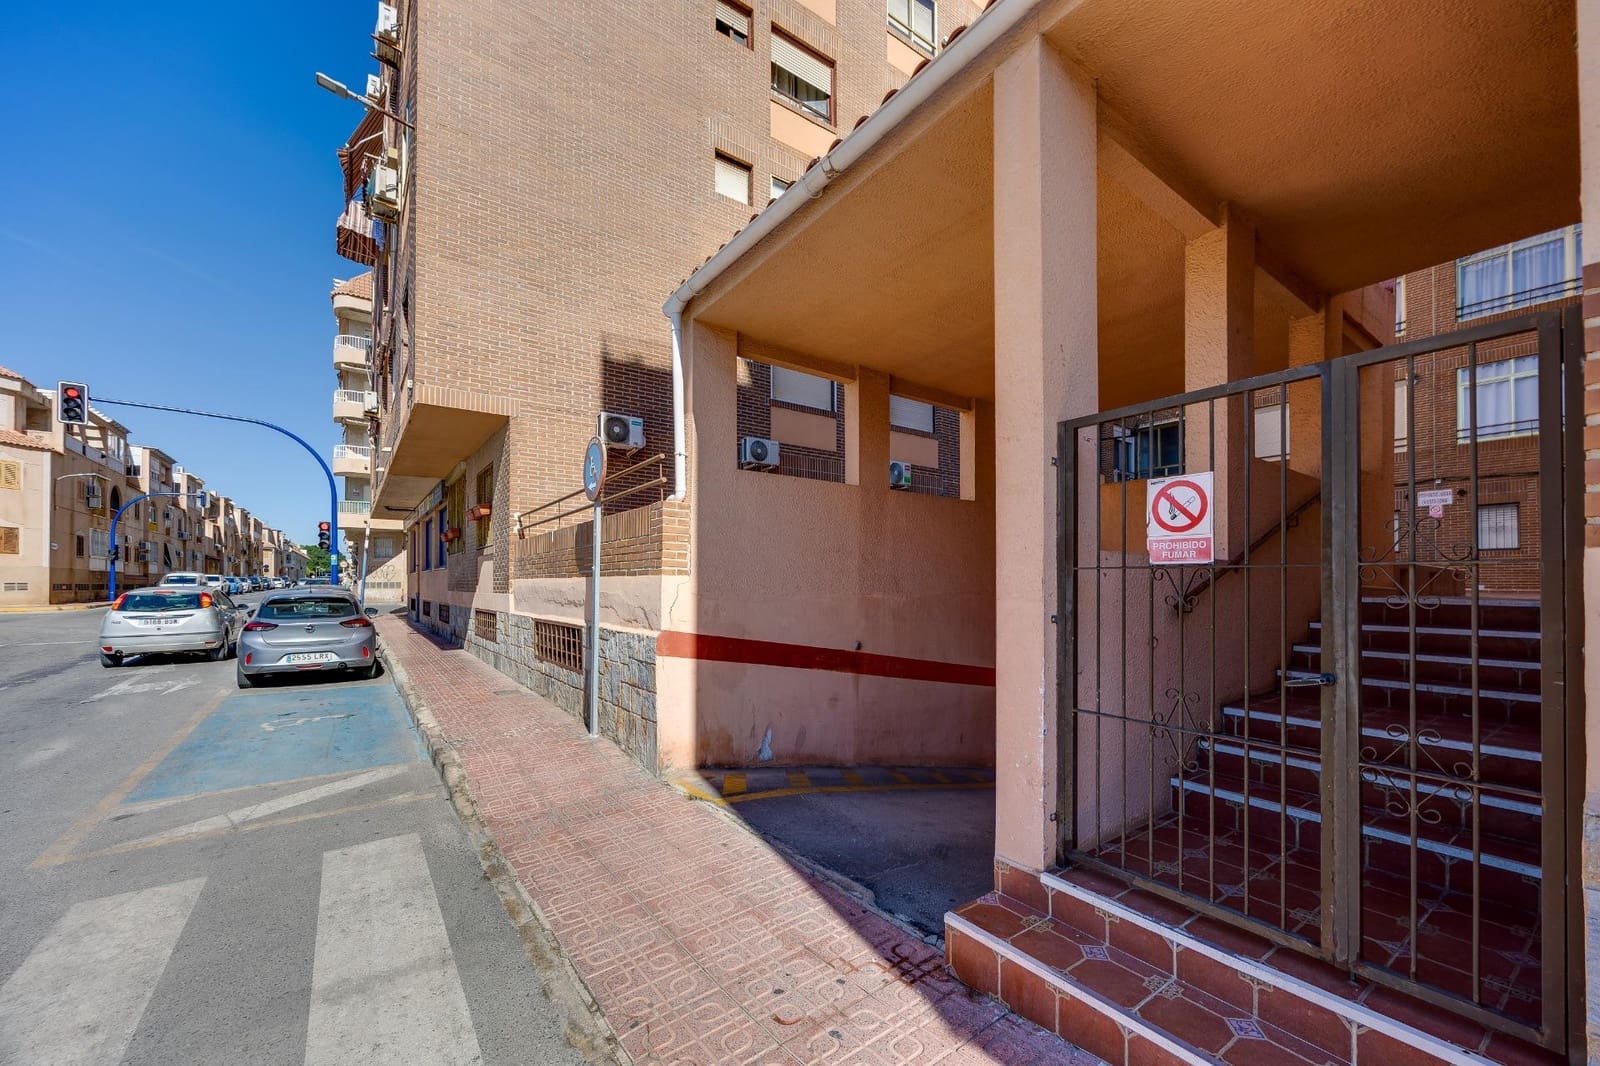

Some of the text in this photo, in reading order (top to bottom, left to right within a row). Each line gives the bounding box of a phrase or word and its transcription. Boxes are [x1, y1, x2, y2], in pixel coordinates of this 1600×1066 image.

[1152, 540, 1207, 550] PROHIBIDO
[1162, 550, 1197, 559] FUMAR
[291, 652, 329, 662] 2555 LRX
